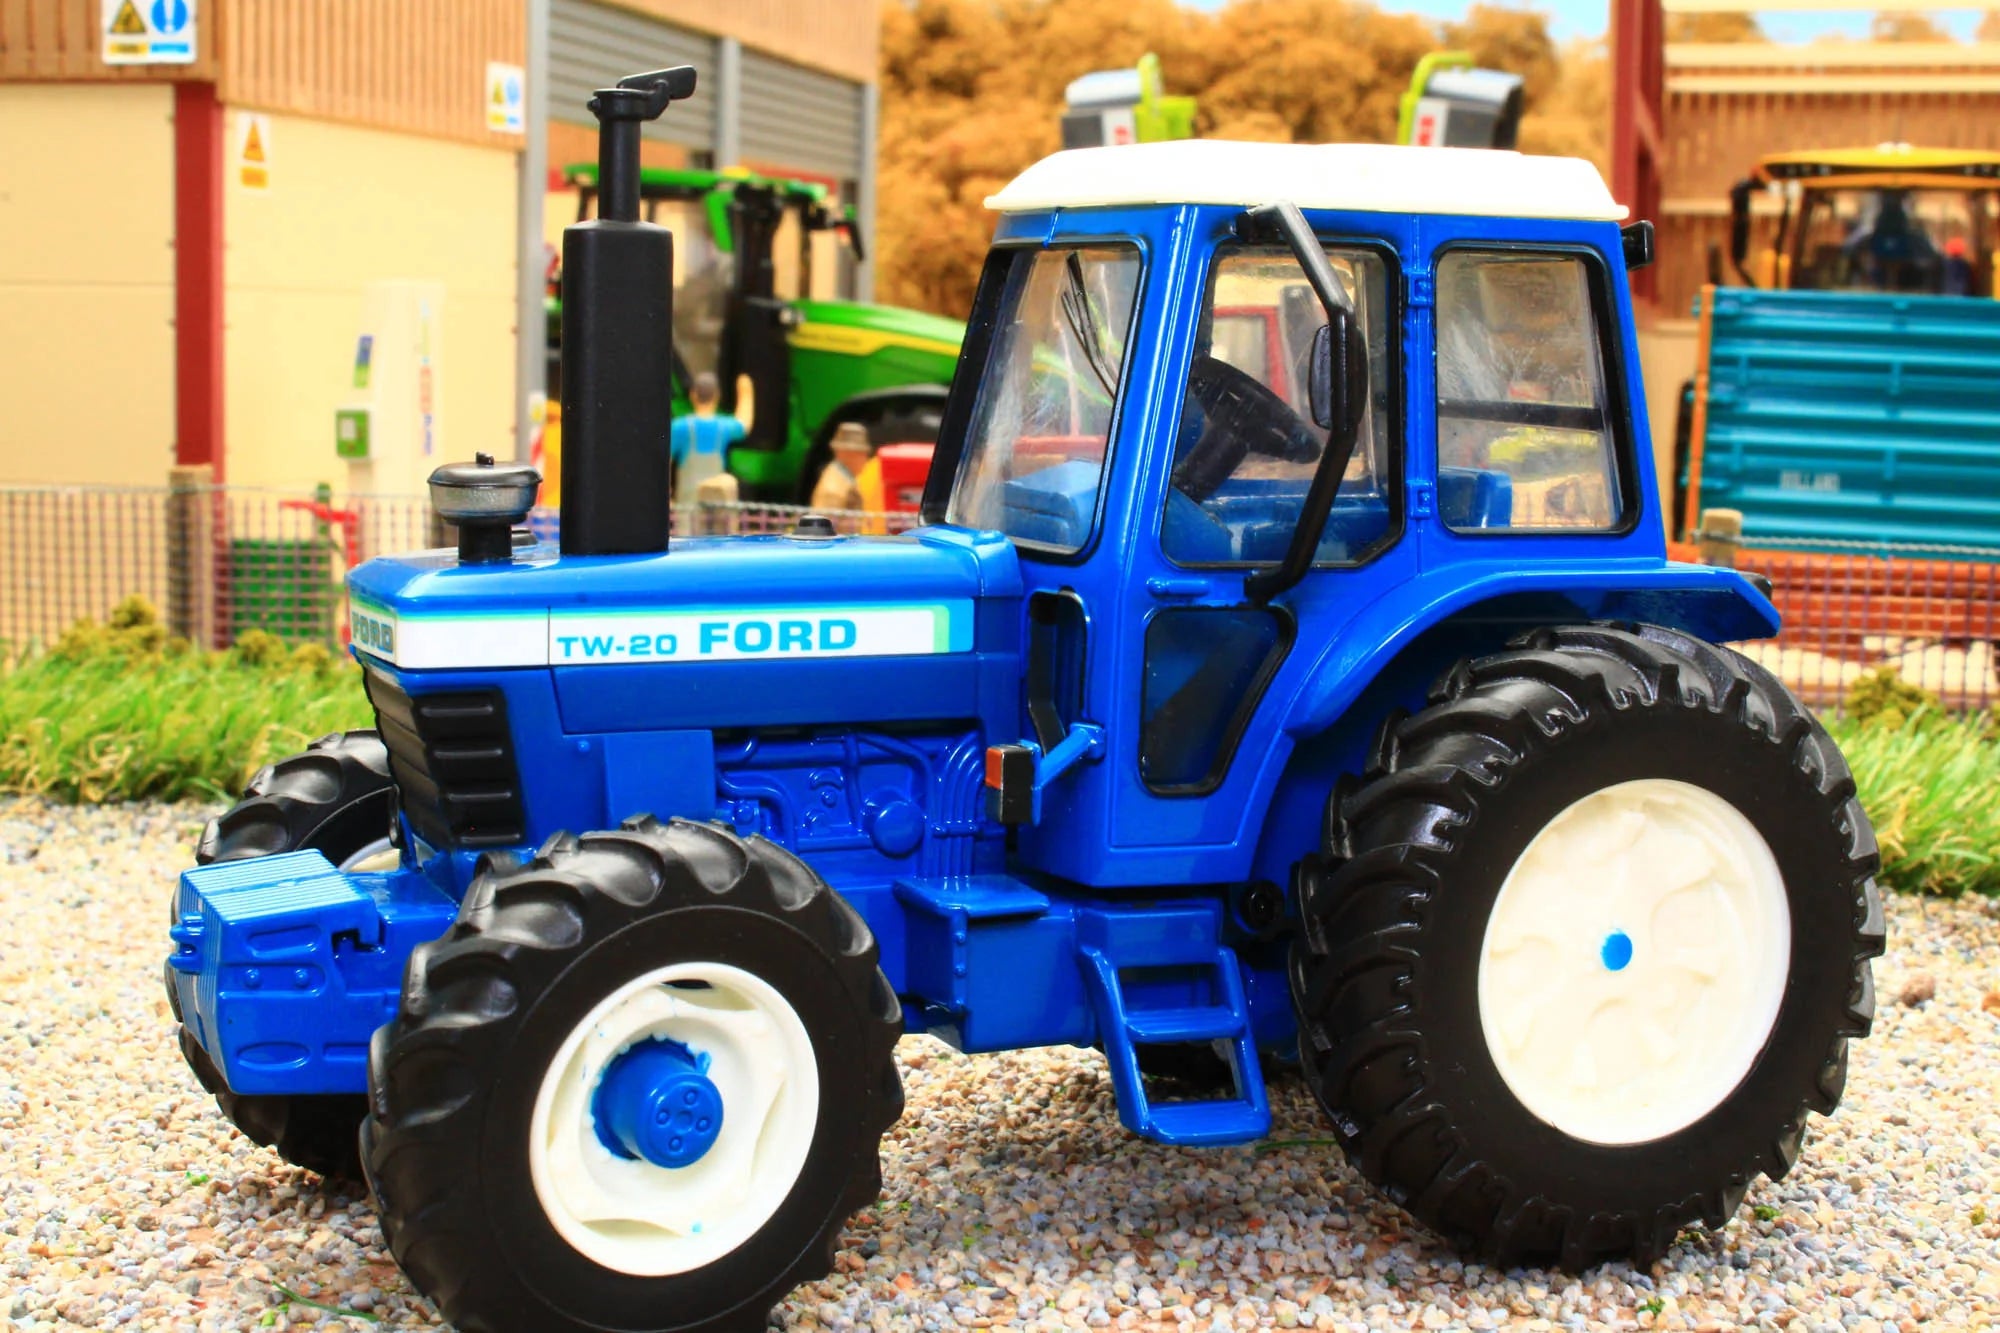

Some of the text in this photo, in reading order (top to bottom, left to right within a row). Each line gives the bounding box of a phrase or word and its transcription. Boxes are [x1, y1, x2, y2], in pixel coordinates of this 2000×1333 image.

[351, 610, 394, 655] FORD
[556, 619, 857, 658] TW-20 FORD
